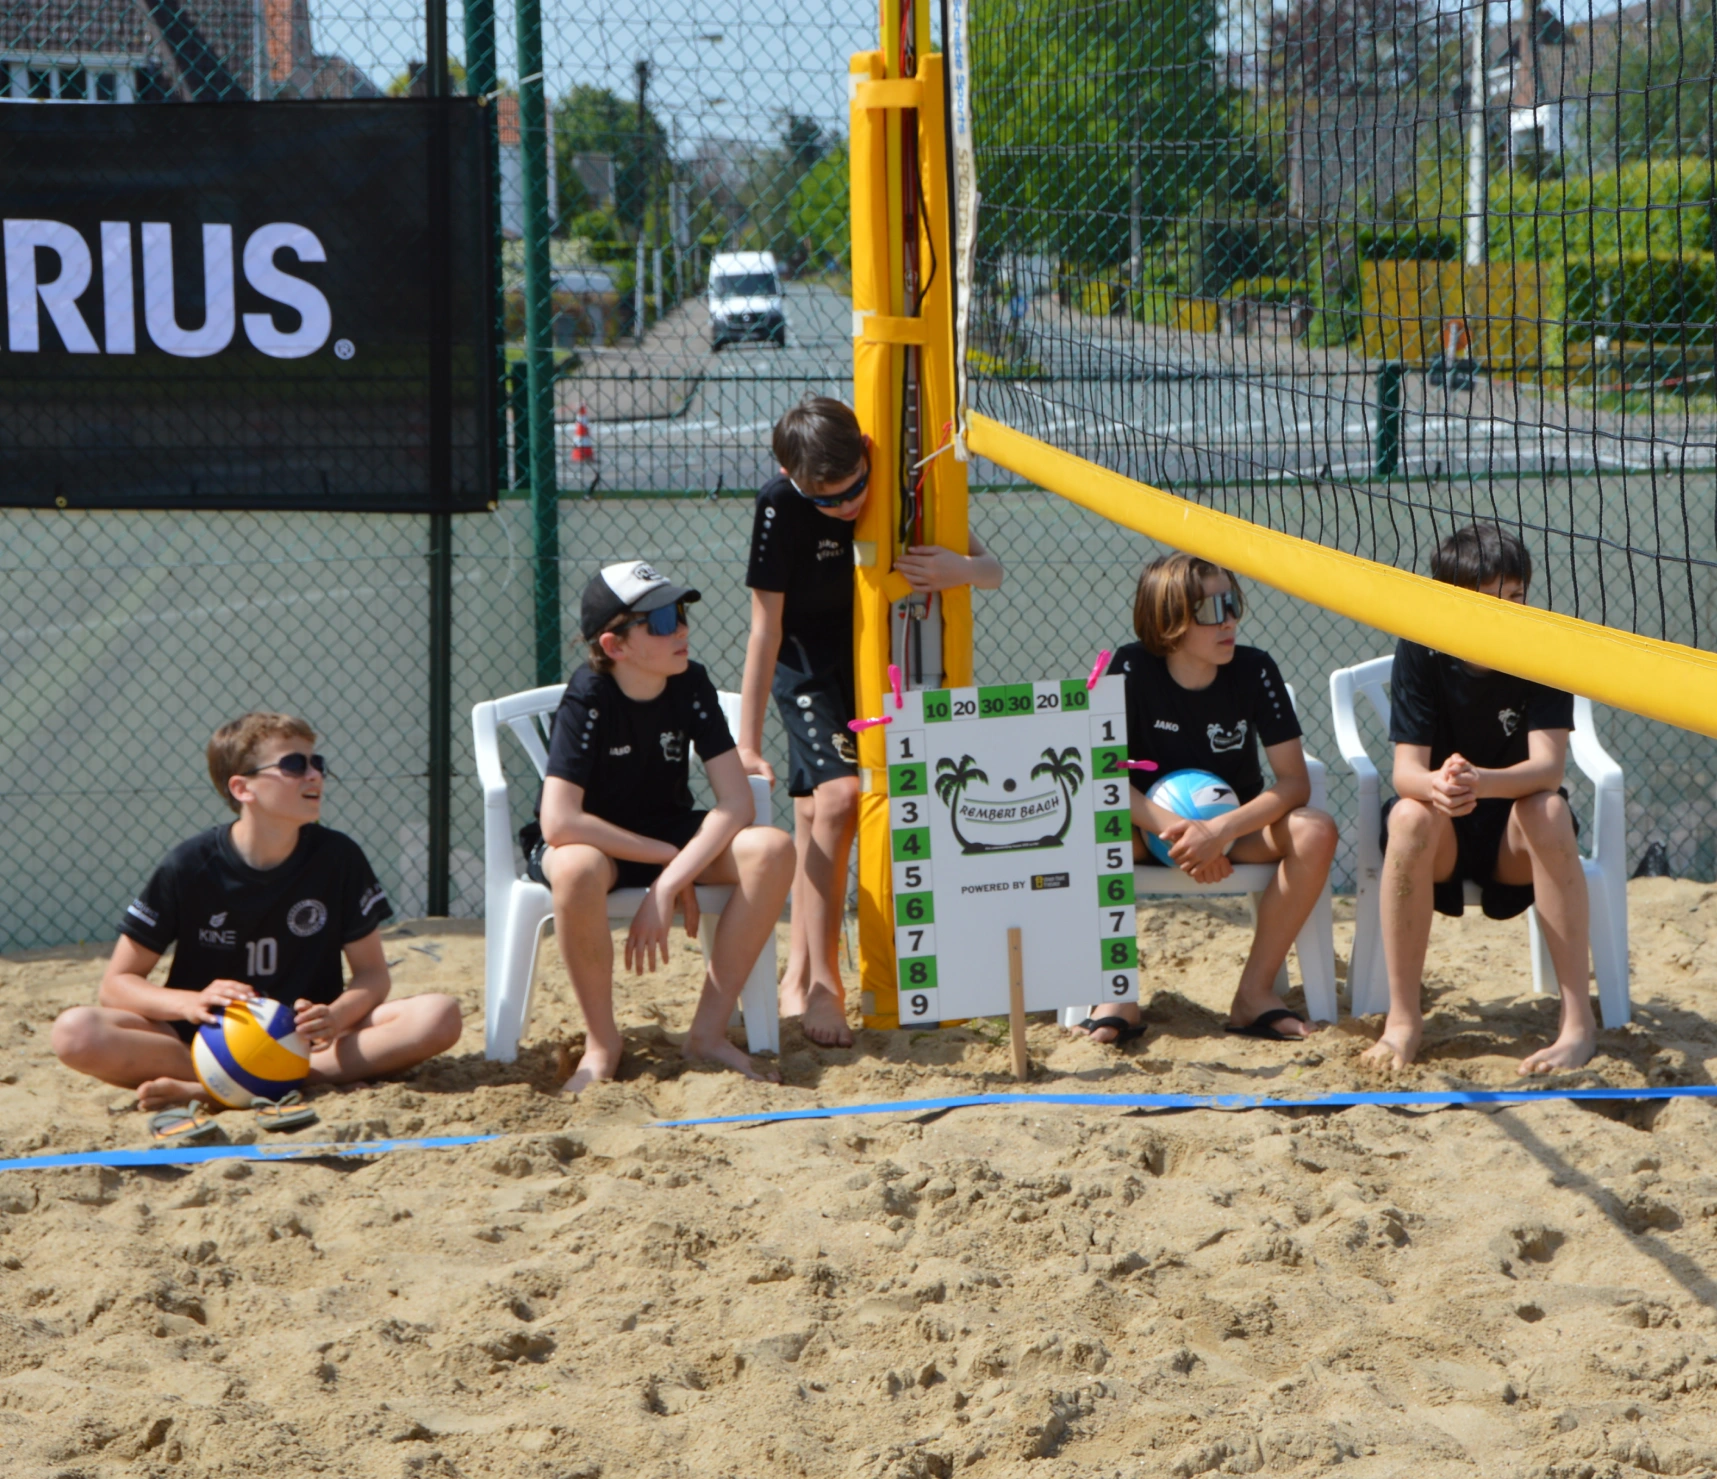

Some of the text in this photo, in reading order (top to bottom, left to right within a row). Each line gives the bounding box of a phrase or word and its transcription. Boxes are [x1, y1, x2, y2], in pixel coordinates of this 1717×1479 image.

[954, 74, 966, 134] Sports
[926, 691, 1086, 719] 10 20 30 30 20 10
[1101, 720, 1117, 742] 1
[1153, 719, 1180, 733] JAKO
[899, 737, 915, 759] 1
[1102, 751, 1122, 774] 2
[900, 769, 917, 792] 2
[1103, 784, 1120, 806] 3
[901, 802, 919, 824] 3
[959, 795, 1060, 820] REMBERT BEACH
[1103, 815, 1122, 837] 4
[902, 833, 921, 855] 4
[1106, 848, 1123, 870] 5
[904, 866, 922, 888] 5
[961, 880, 1026, 895] POWERED BY
[1107, 879, 1125, 901] 6
[906, 898, 924, 920] 6
[1109, 911, 1125, 933] 7
[198, 927, 237, 945] KINE
[908, 930, 924, 952] 7
[246, 937, 278, 976] 10
[1110, 942, 1129, 965] 8
[909, 962, 928, 984] 8
[1112, 974, 1129, 996] 9
[911, 994, 929, 1016] 9
